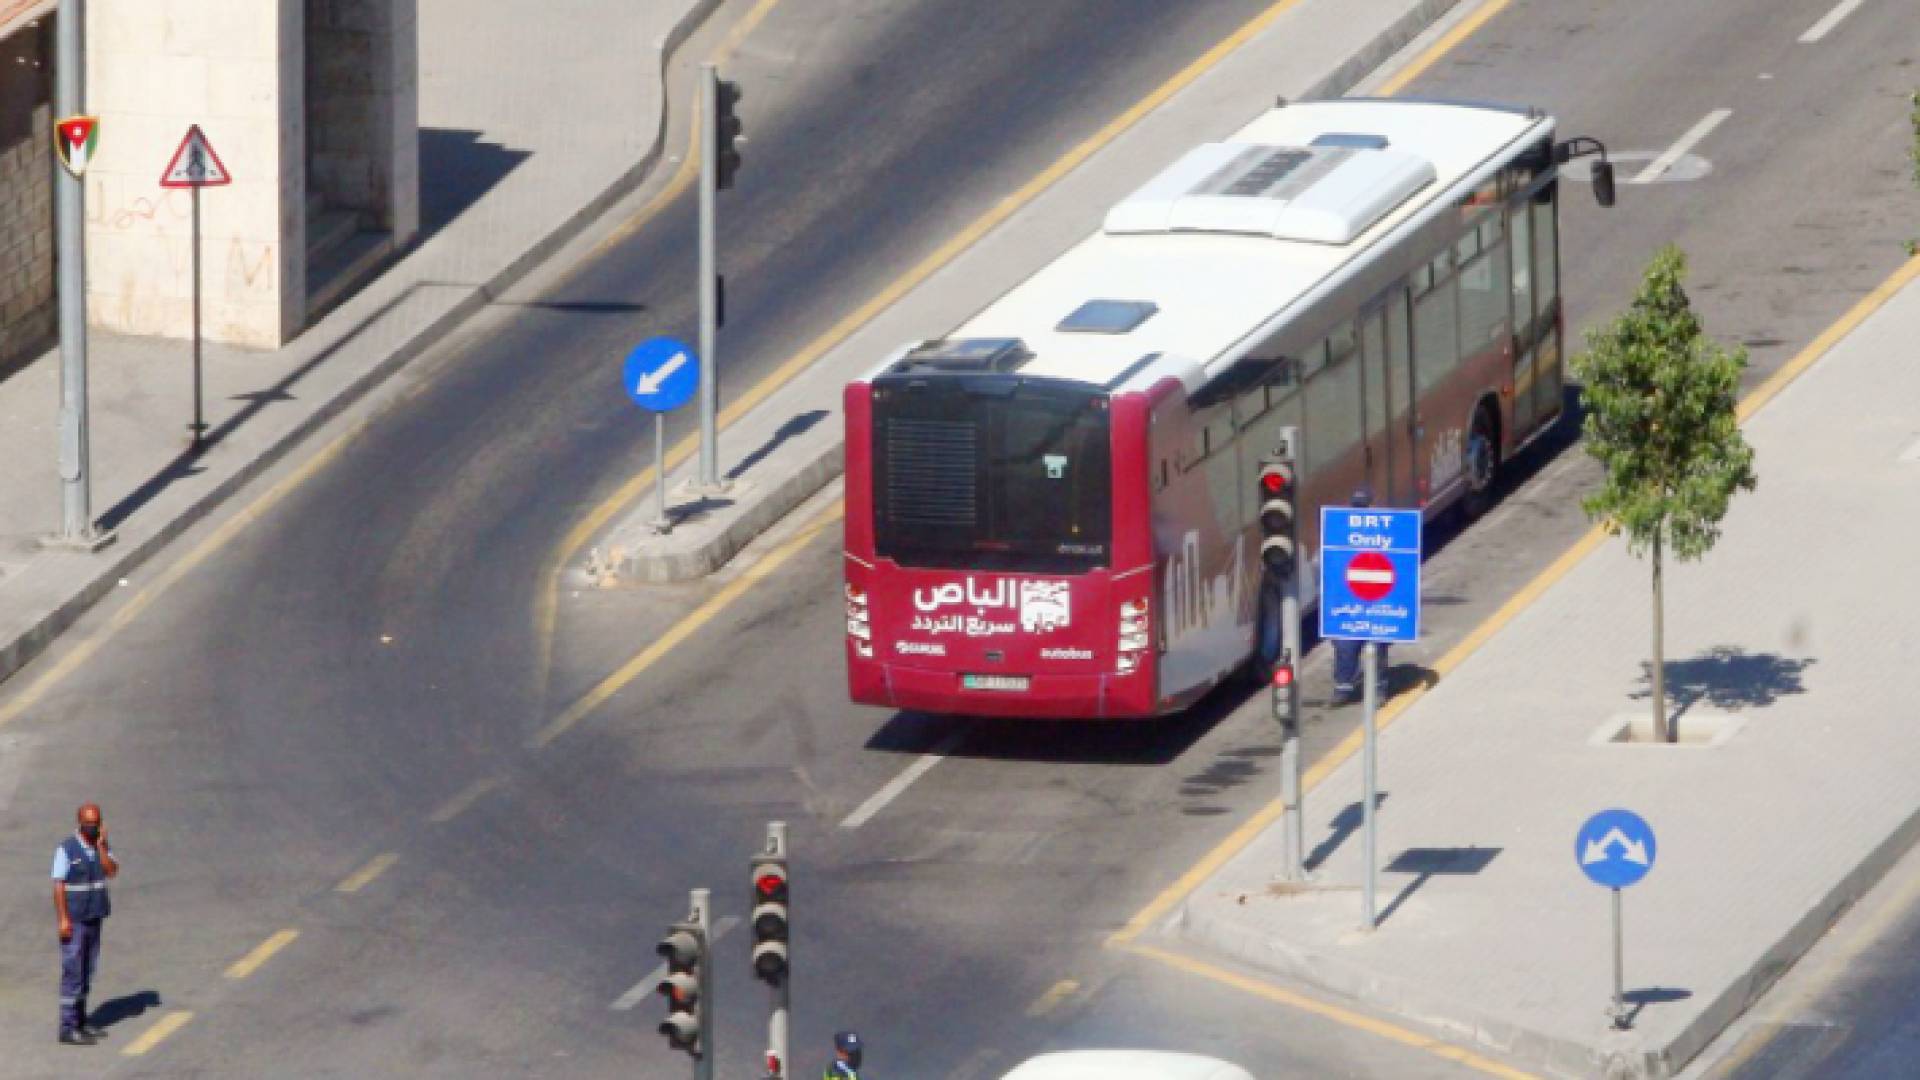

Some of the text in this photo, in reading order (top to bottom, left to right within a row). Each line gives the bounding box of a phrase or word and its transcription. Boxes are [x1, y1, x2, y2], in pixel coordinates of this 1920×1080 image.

[1349, 515, 1393, 528] BRT
[1348, 532, 1393, 550] Only
[914, 576, 1016, 616] الباص
[912, 615, 1016, 637] سريع التردد
